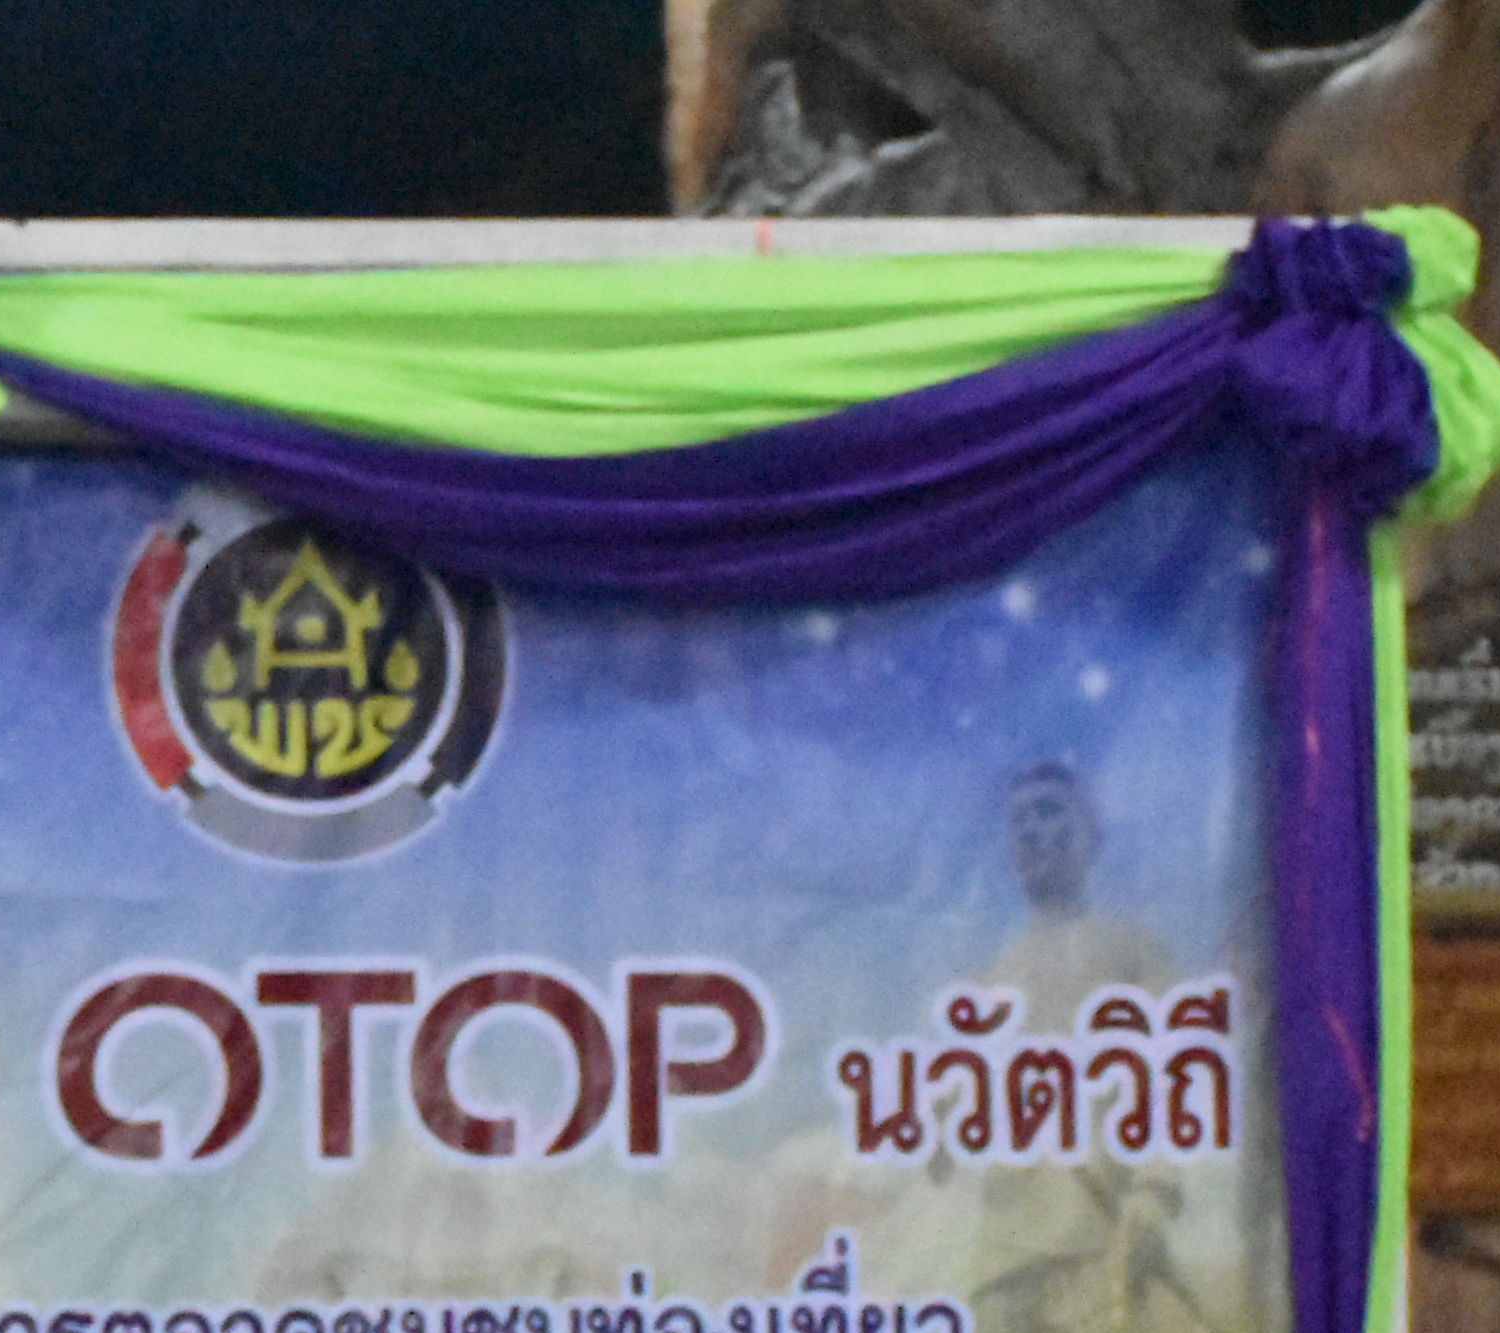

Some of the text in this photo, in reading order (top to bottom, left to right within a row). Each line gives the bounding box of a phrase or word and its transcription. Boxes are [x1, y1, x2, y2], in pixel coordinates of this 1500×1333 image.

[56, 970, 768, 1160] OTOP
[838, 992, 1233, 1152] นวัตวิถี
